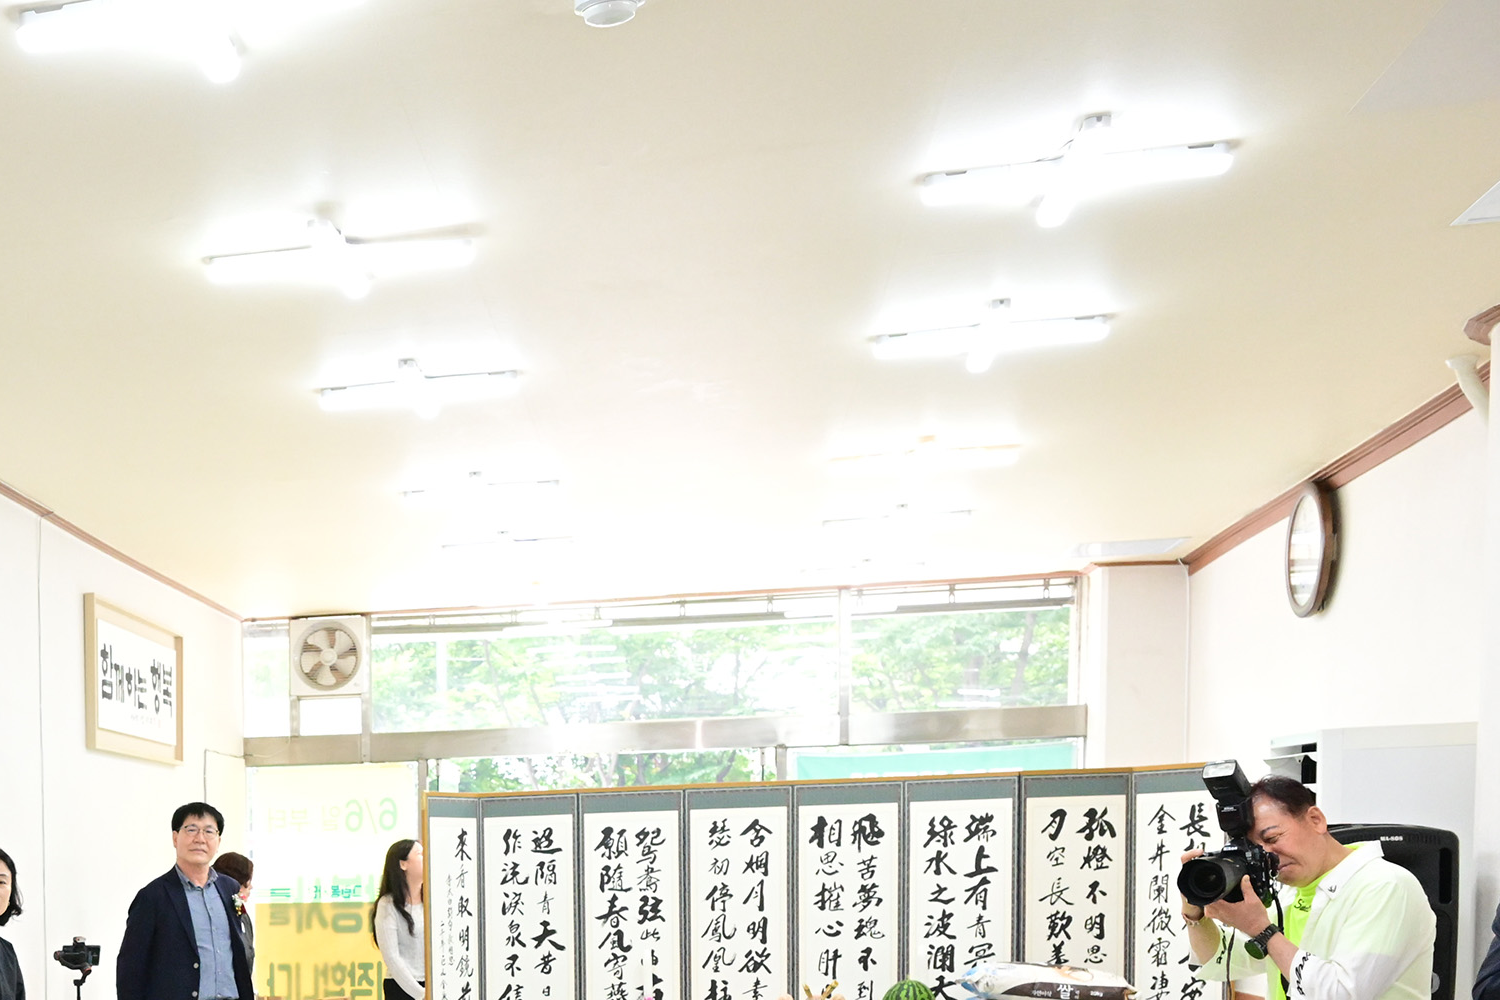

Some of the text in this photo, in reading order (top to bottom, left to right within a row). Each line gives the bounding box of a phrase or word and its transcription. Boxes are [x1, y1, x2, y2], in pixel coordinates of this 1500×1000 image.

[100, 643, 172, 718] 함께하는 행복
[1057, 984, 1073, 1000] 쌀
